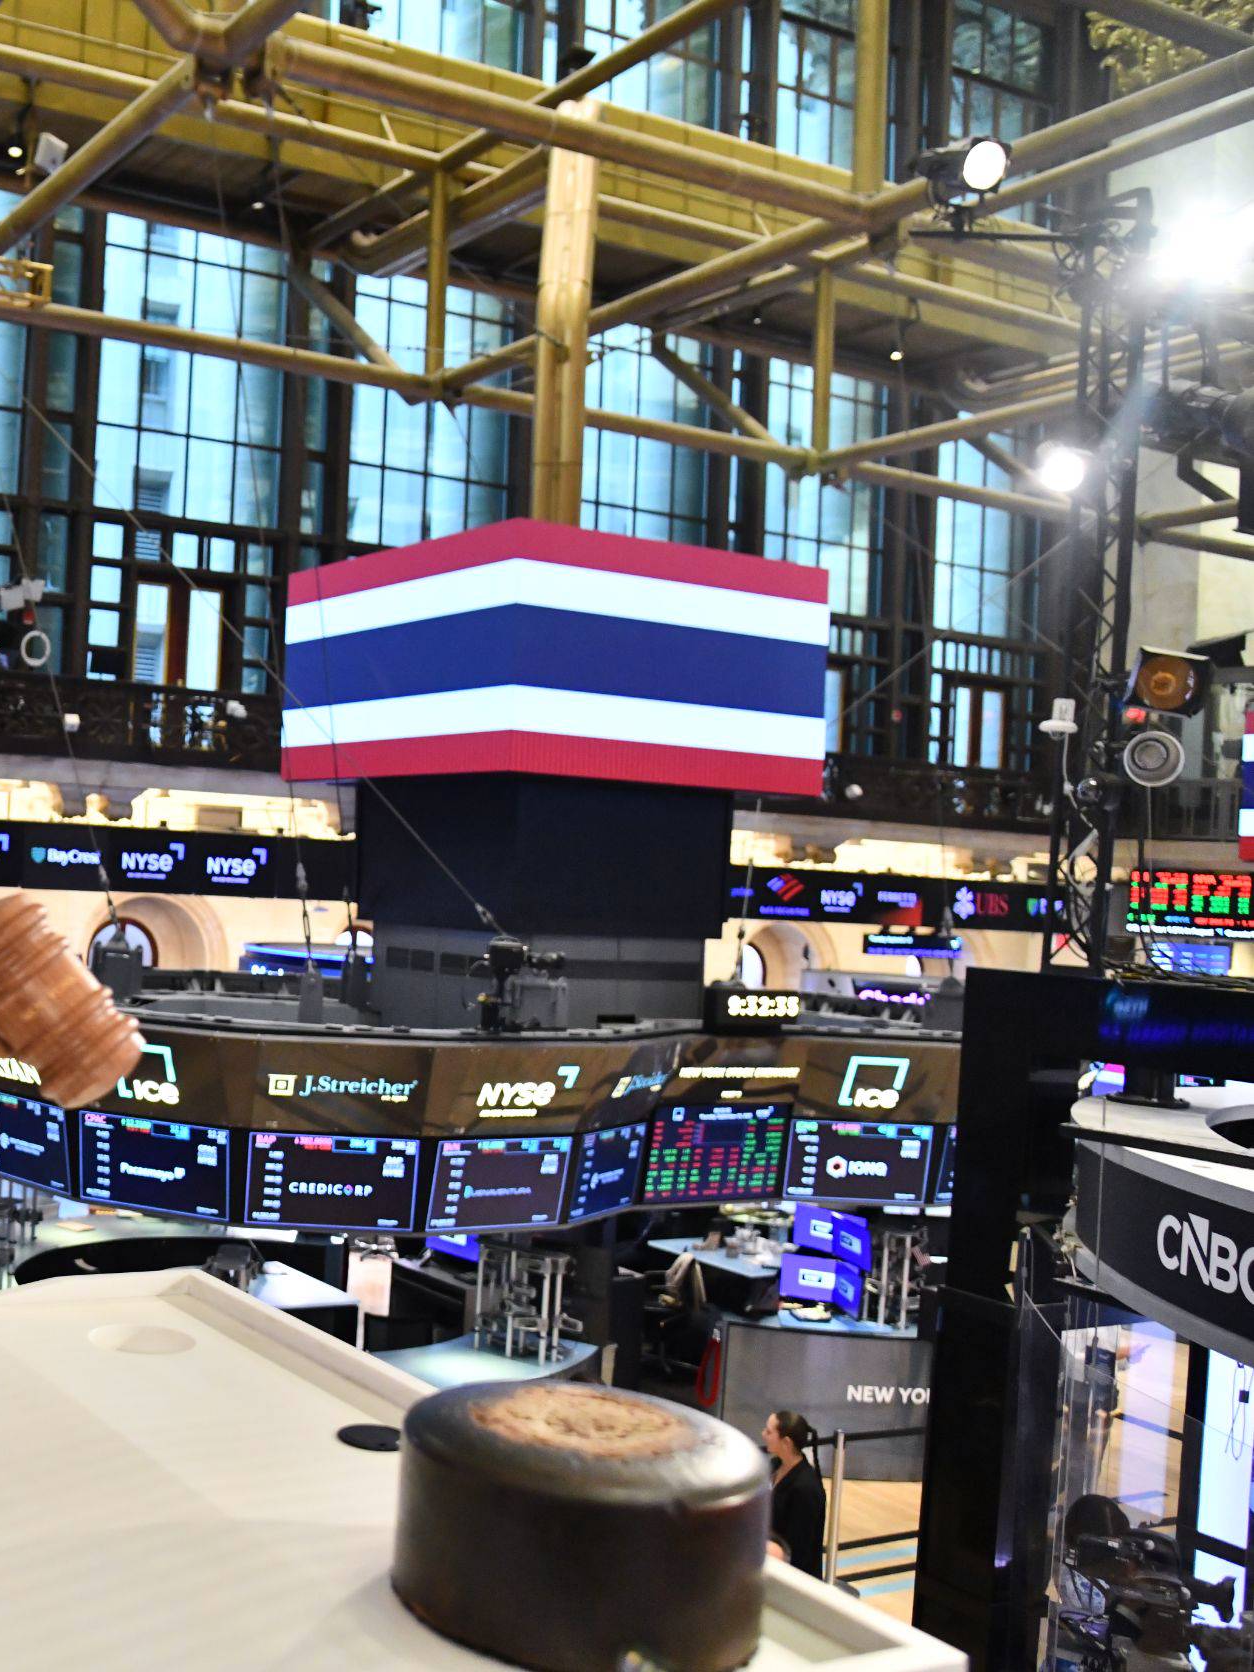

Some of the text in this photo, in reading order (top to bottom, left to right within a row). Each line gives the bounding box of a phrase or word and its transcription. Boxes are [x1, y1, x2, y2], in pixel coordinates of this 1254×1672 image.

[976, 892, 1010, 916] UBS
[299, 1074, 416, 1097] J.Streicher
[289, 1181, 373, 1197] CREDICORP
[847, 1384, 930, 1405] NEW YO
